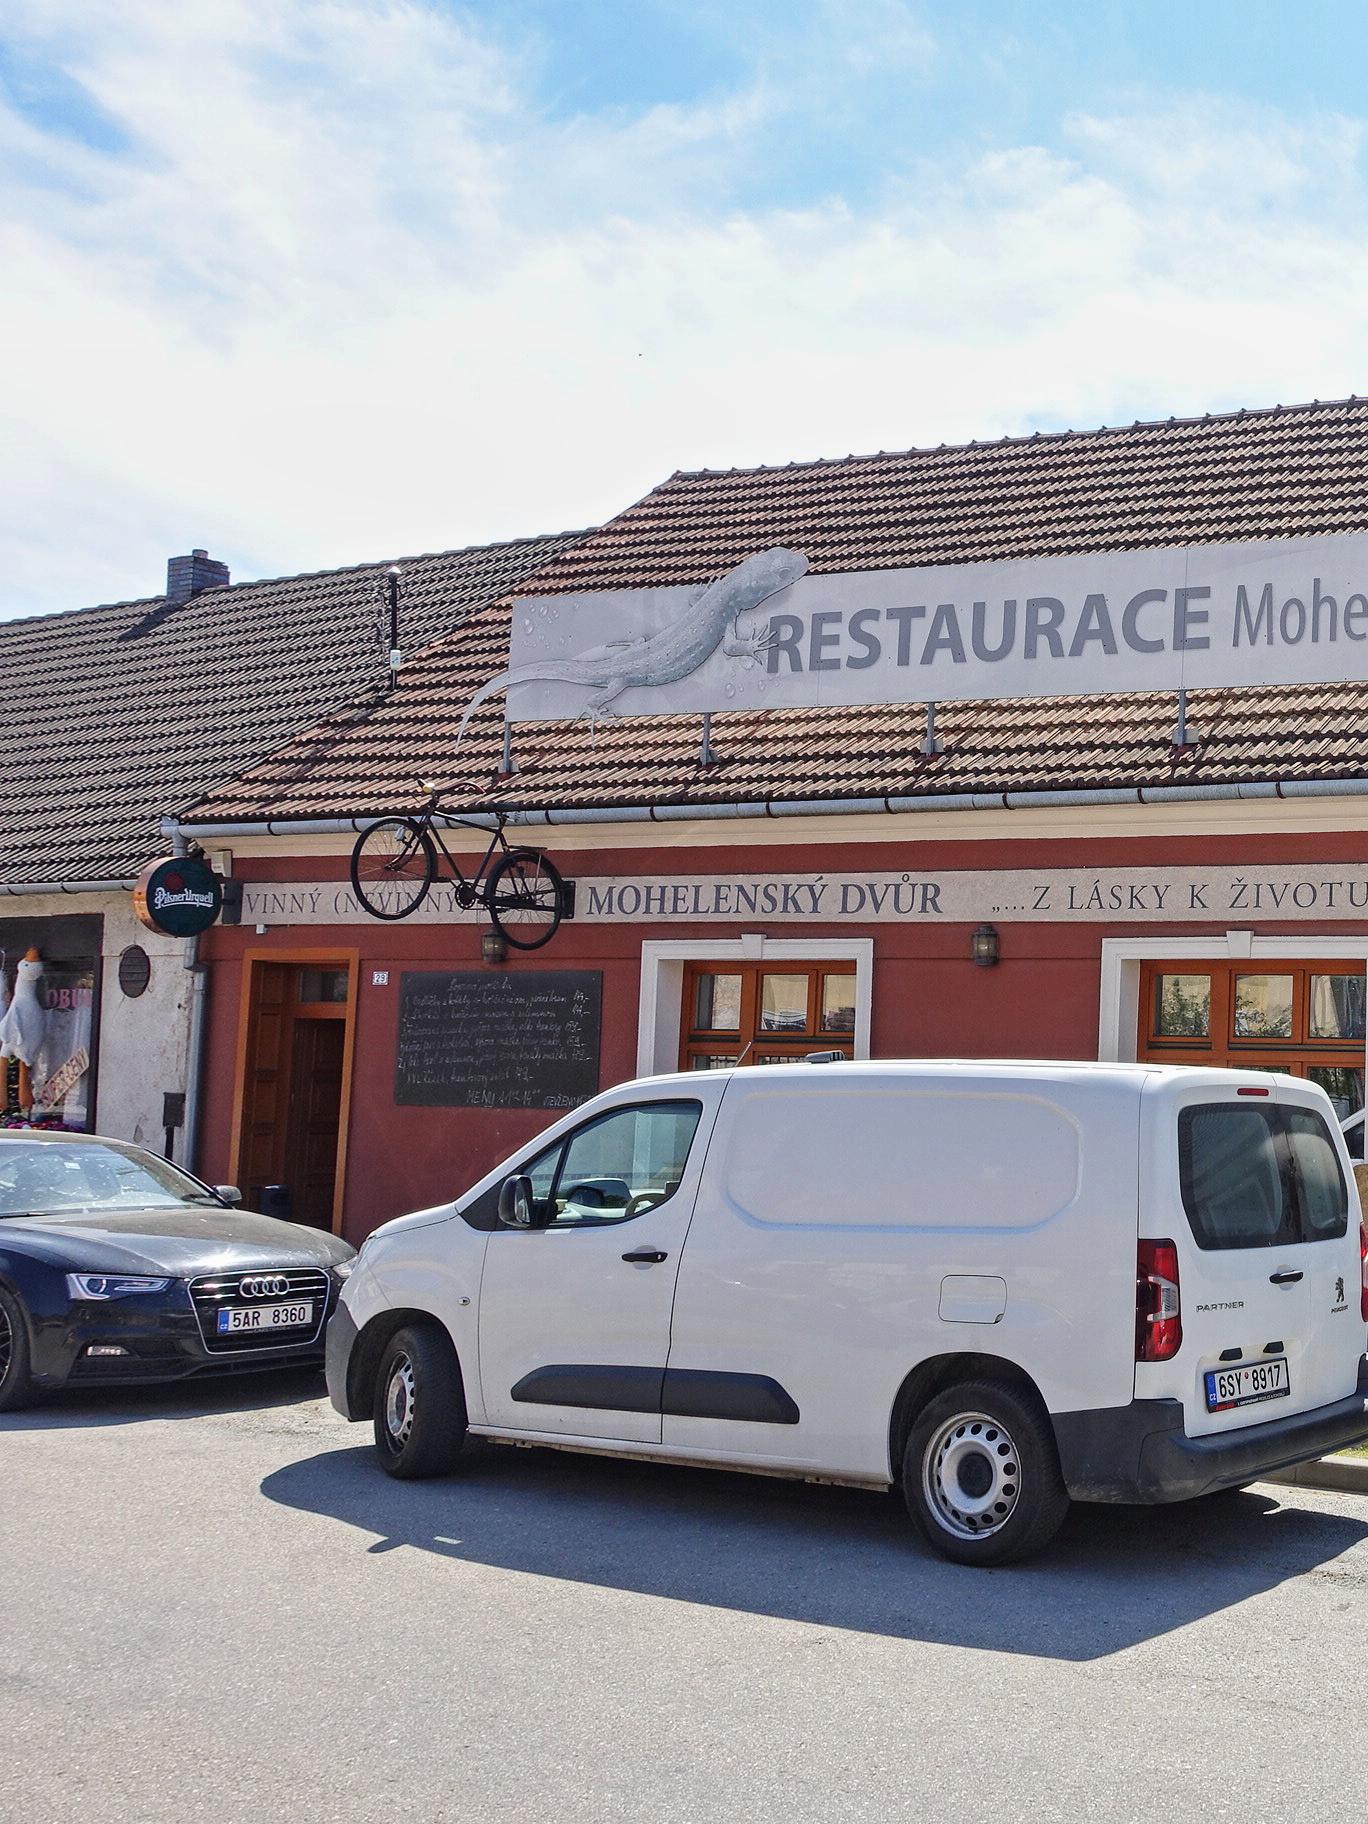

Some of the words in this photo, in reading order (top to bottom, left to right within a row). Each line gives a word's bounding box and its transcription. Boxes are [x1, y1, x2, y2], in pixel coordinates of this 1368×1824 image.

[766, 586, 1212, 675] RESTAURACE
[154, 887, 186, 909] Pilsner
[246, 887, 322, 913] VINNÝ
[586, 875, 828, 916] MOHELENSKÝ
[838, 873, 944, 915] DVŮR
[1067, 879, 1172, 911] LÁSKY
[1188, 884, 1211, 910] K
[233, 1311, 261, 1328] 5AR
[272, 1306, 306, 1324] 8360
[1196, 1301, 1245, 1313] PARTNER
[1218, 1372, 1242, 1399] 6SY
[1251, 1364, 1282, 1392] 8917
[1209, 1392, 1217, 1402] CZ
